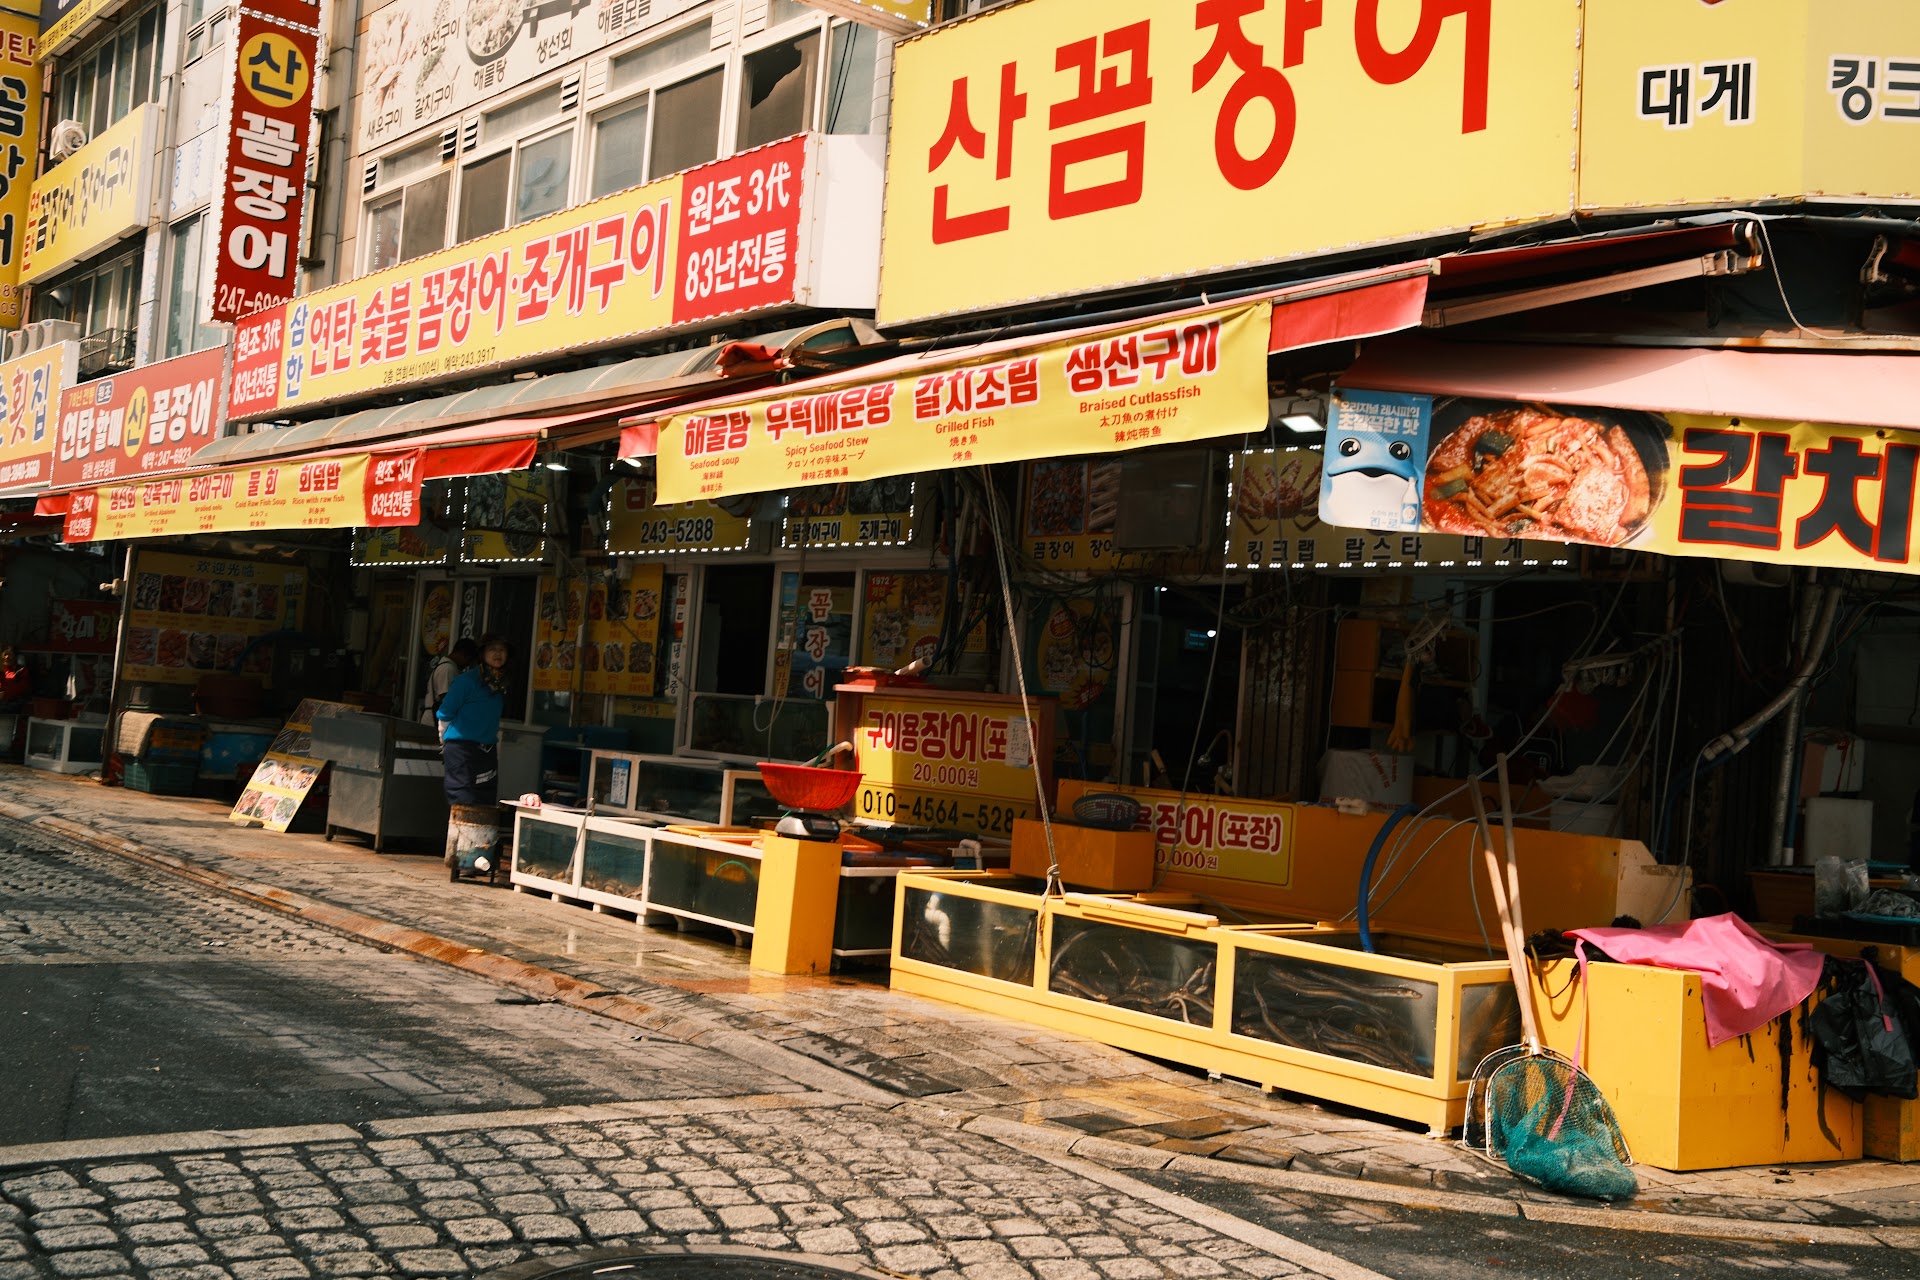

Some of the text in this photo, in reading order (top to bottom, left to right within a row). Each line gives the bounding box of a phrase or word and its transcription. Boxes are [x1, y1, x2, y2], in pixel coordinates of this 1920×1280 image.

[0, 29, 36, 66] 탄
[421, 17, 461, 56] 생선구이
[537, 26, 573, 64] 생선회
[248, 41, 302, 101] 산
[473, 60, 507, 91] 해물탕
[415, 82, 455, 120] 갈치구이
[1641, 63, 1752, 125] 대게
[367, 107, 403, 141] 새우구이
[80, 136, 135, 228] 장어구이
[228, 111, 300, 278] 꼼장어
[688, 161, 792, 237] 원조 3代
[22, 188, 40, 272] 연탄
[685, 228, 787, 301] 83년전통
[237, 318, 282, 362] 원조 3代
[310, 295, 358, 378] 연탄
[360, 282, 412, 366] 숯불
[1066, 320, 1221, 393] 생선구이
[233, 362, 278, 407] 83년전통
[915, 357, 1039, 419] 갈치조림
[1080, 385, 1201, 414] Braised Cutlassfish
[766, 383, 895, 441] 우럭매운탕
[935, 416, 995, 434] Grilled Fish
[1100, 406, 1179, 427] 太刀魚の煮付け
[1340, 401, 1420, 419] 오리지널 레시피의
[1403, 418, 1419, 435] 맛
[61, 407, 95, 462] 연탄
[94, 407, 125, 452] 할매
[127, 396, 145, 447] 산
[684, 411, 751, 456] 해물탕
[785, 436, 869, 458] Spicy Seafood Stew
[299, 462, 341, 494] 회덮밥
[375, 457, 417, 485] 원조 3대
[690, 456, 739, 470] Seafood soup
[110, 485, 138, 511] 생선회
[142, 479, 183, 507] 전복구이
[190, 473, 234, 502] 장어구이
[371, 490, 413, 518] 83년전통
[1678, 427, 1920, 564] 갈치
[640, 518, 714, 544] 243-5288
[859, 519, 901, 539] 조개구이
[1034, 541, 1074, 559] 꼼장어
[872, 576, 890, 585] 1972
[805, 592, 831, 699] 꼼장어
[914, 763, 978, 787] 20,000원
[863, 789, 1027, 833] 010-4564-528
